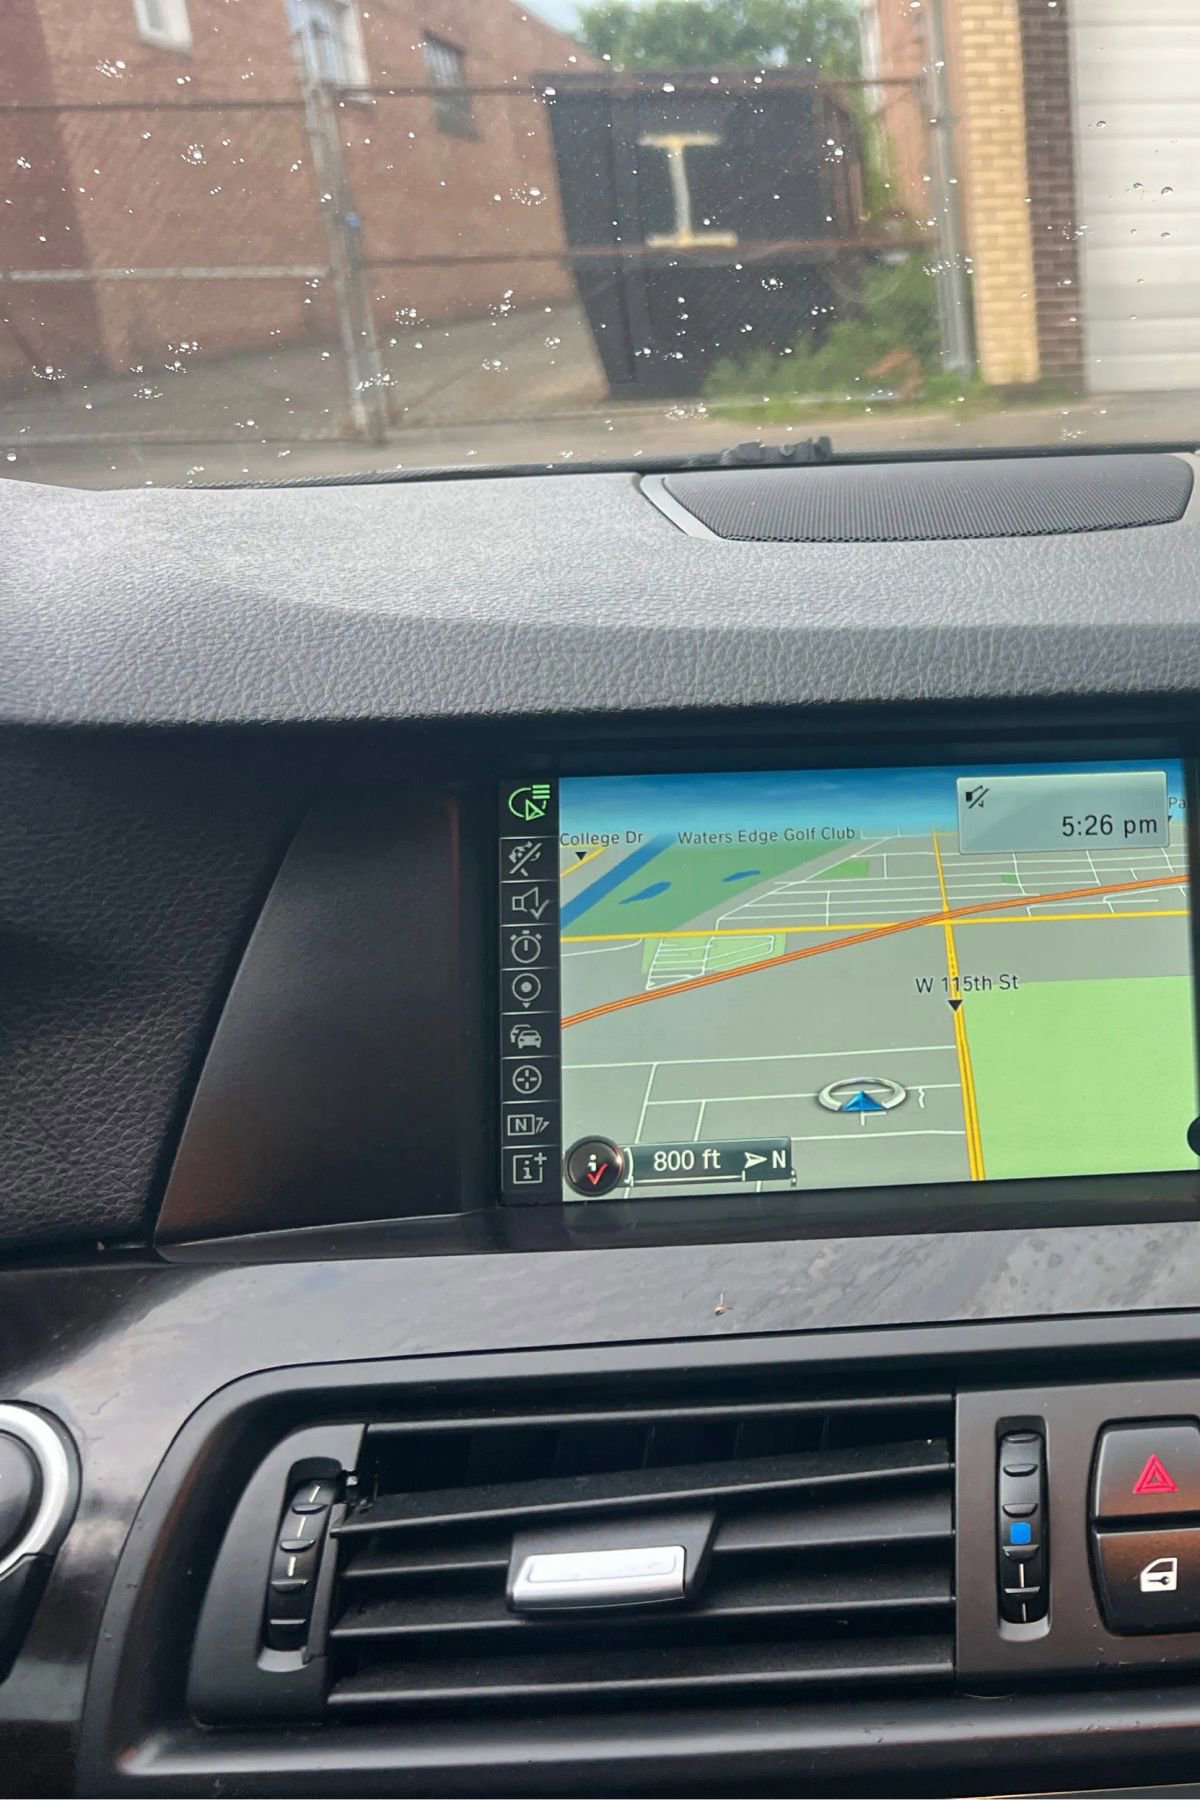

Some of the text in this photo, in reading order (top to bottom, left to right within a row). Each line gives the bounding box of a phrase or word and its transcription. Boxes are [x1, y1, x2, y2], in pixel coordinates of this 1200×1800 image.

[678, 826, 856, 845] Waters Edge Golf Club
[1061, 814, 1158, 838] 5:26 pm
[560, 831, 644, 848] College Dr
[915, 973, 1019, 994] W 115th St
[653, 1148, 721, 1172] 800 ft
[771, 1150, 787, 1169] N
